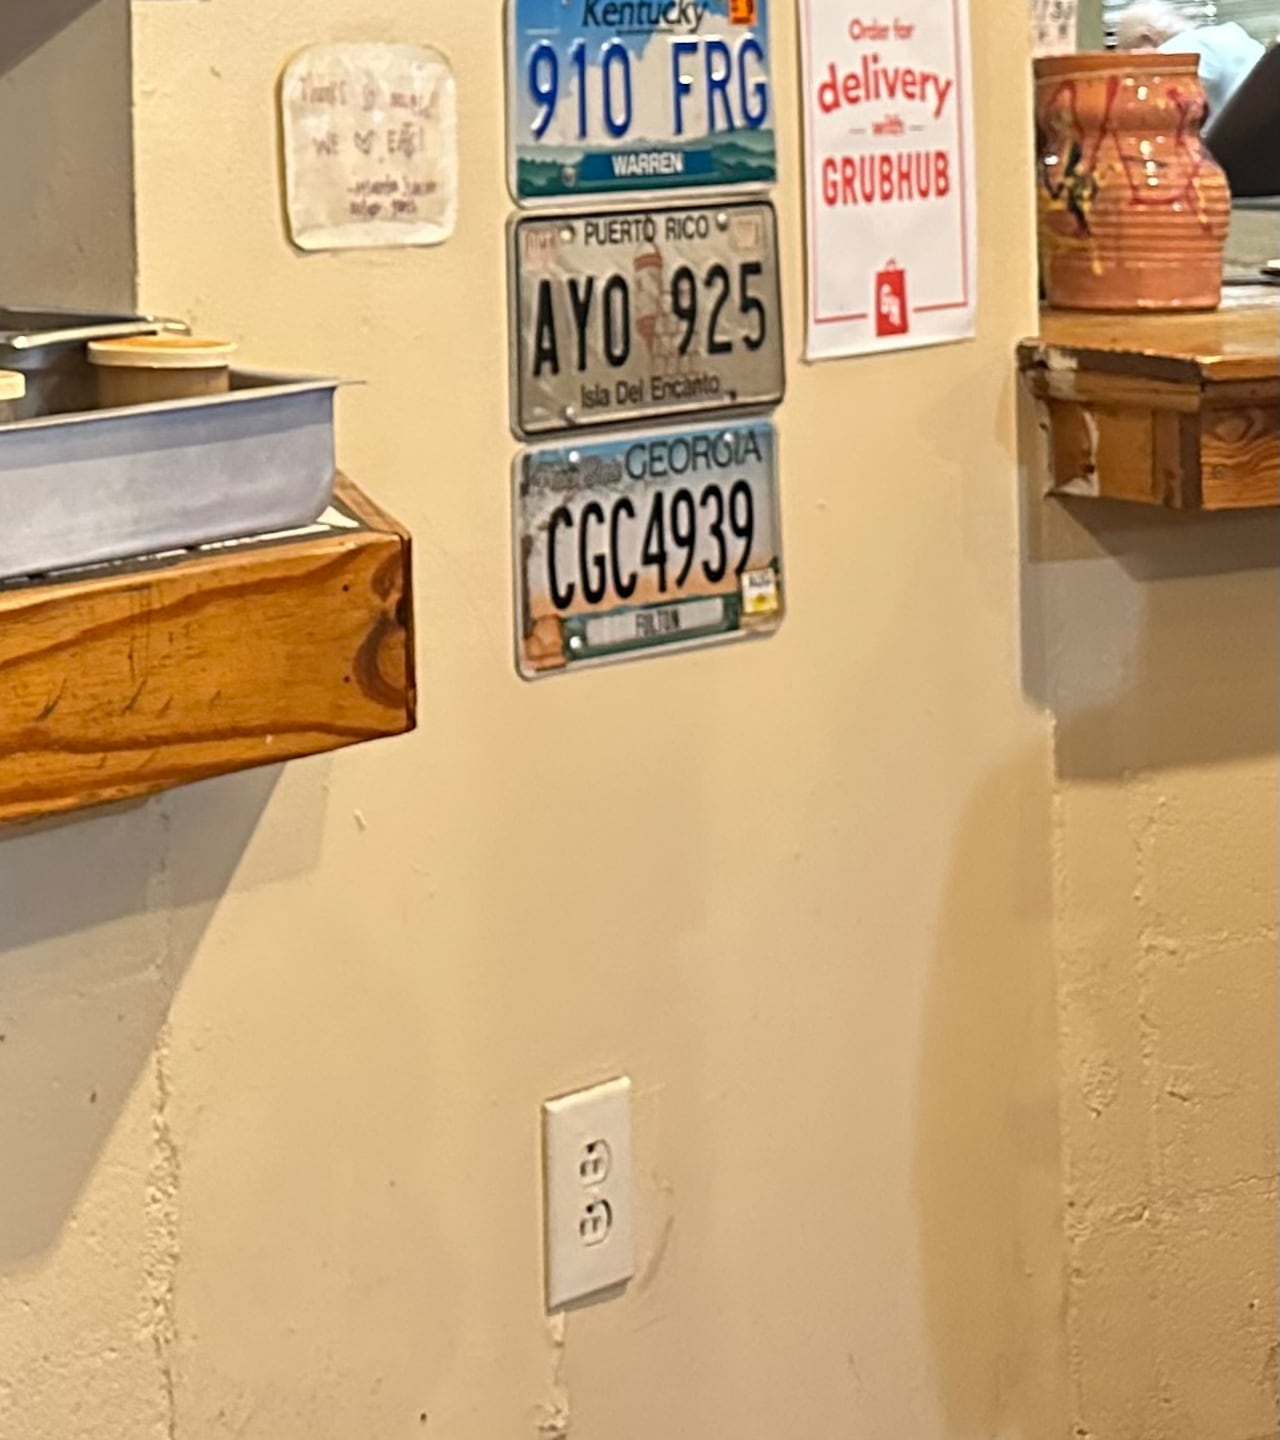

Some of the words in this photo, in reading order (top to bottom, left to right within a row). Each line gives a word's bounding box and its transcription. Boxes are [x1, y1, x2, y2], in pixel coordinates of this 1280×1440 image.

[849, 18, 889, 41] Order
[893, 16, 915, 40] for
[528, 38, 632, 142] 910
[668, 32, 768, 135] FRG
[817, 53, 952, 118] delivery
[872, 113, 904, 136] with
[611, 151, 684, 176] WARREN
[822, 150, 950, 207] GRUBHUB
[584, 217, 656, 246] PUERTO
[665, 214, 709, 241] RICO
[533, 274, 630, 378] AYO
[672, 262, 766, 356] 925
[581, 384, 610, 408] Isla
[616, 379, 644, 404] Del
[651, 373, 720, 402] Encanto
[625, 429, 762, 480] GEORGIA
[548, 479, 754, 610] CGC4939
